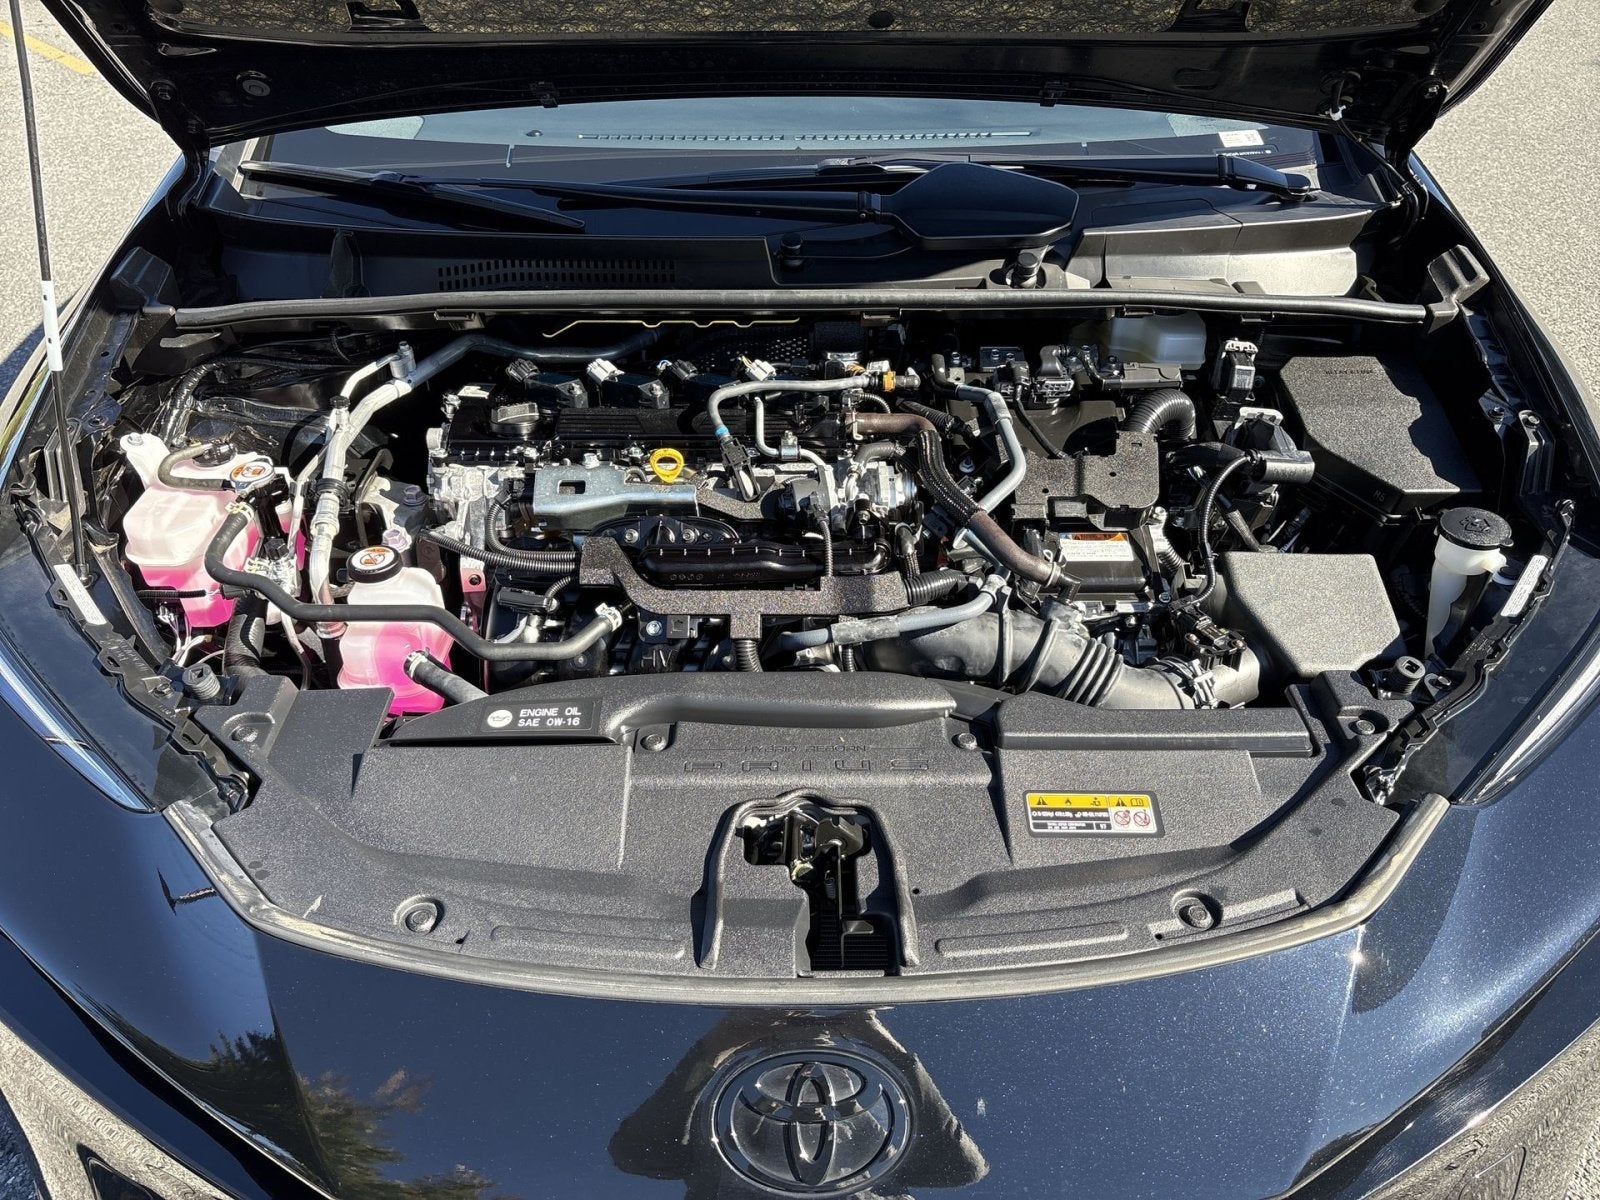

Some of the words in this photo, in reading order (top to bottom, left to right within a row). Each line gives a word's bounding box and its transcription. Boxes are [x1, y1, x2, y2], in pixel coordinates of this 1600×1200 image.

[641, 649, 672, 668] HV
[520, 708, 559, 717] ENGINE
[565, 706, 582, 716] OIL
[518, 718, 541, 727] SAE
[805, 744, 867, 752] REBORN
[684, 759, 929, 772] PRIUS
